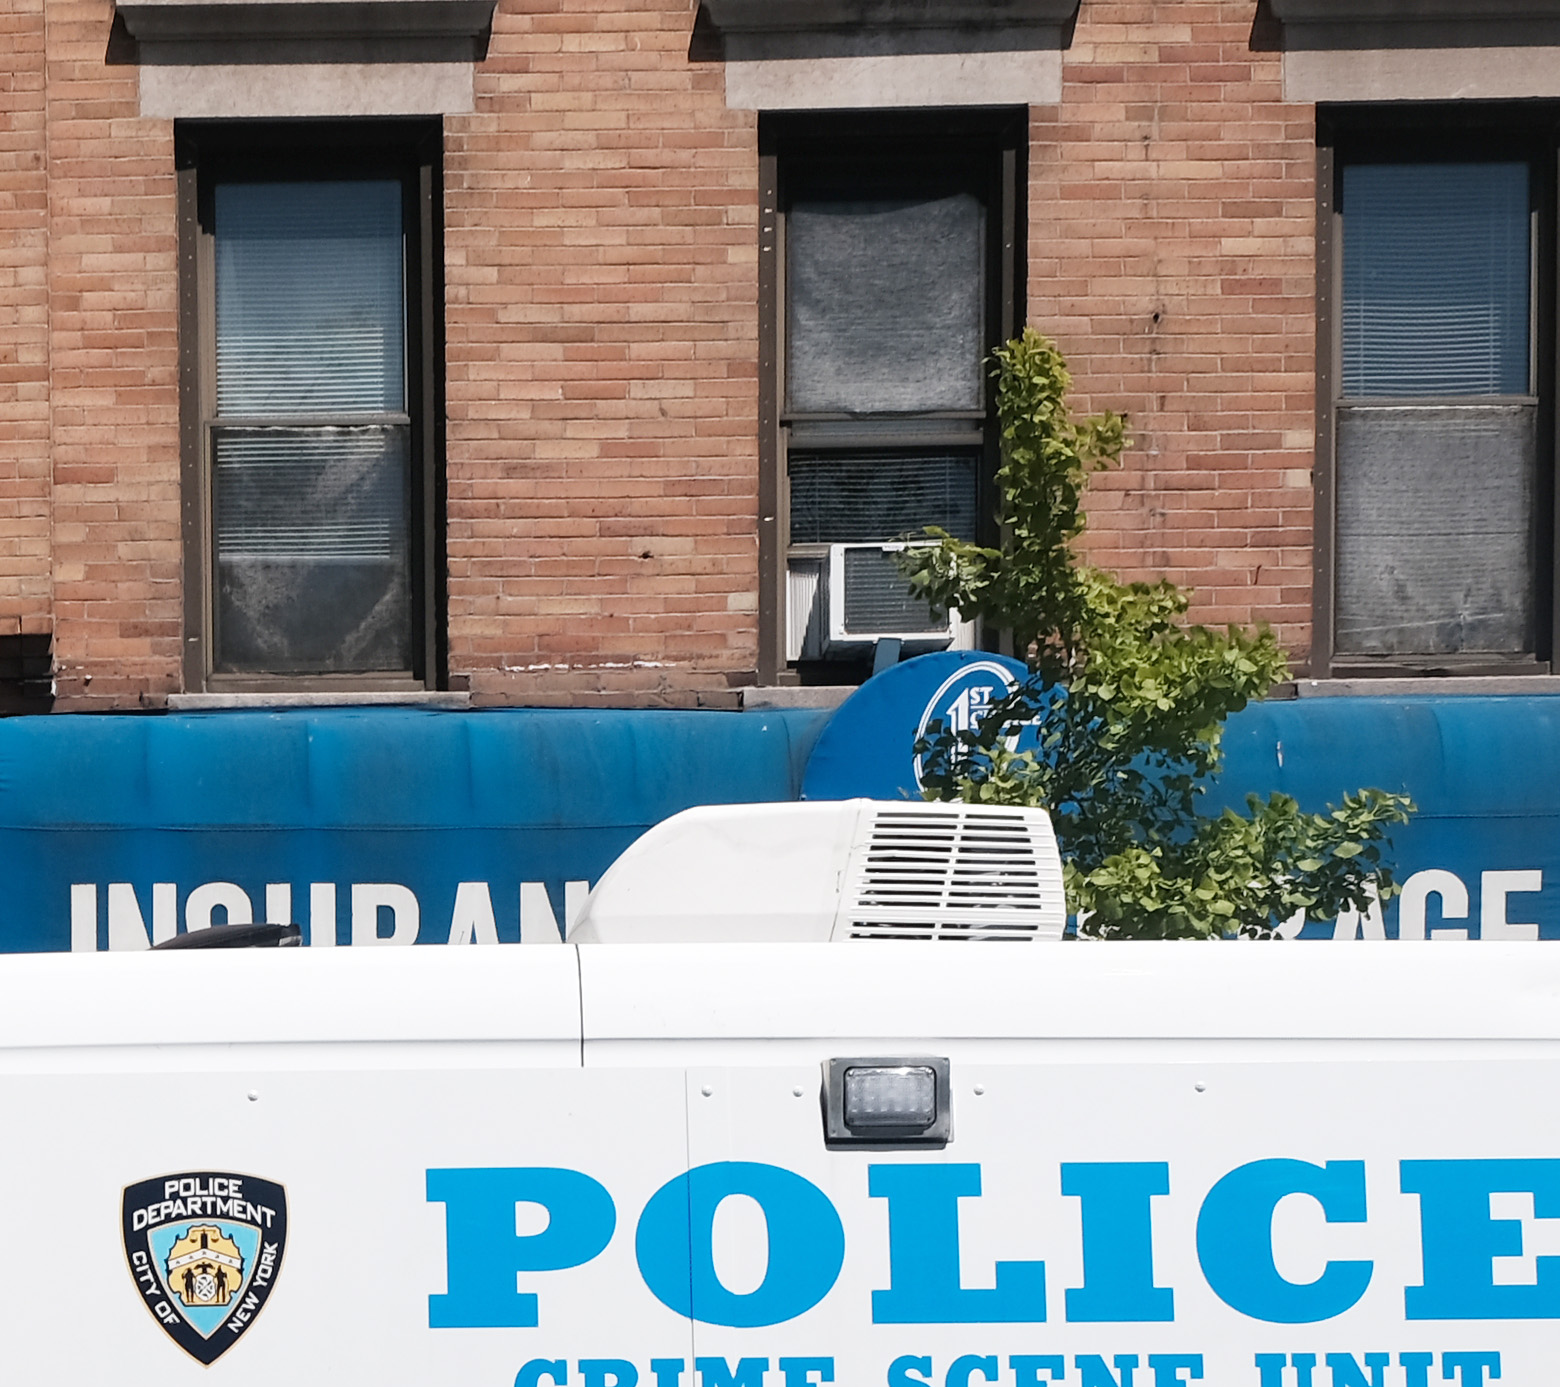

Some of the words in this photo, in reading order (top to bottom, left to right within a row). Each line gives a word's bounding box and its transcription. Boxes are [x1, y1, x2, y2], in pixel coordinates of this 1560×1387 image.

[133, 1197, 276, 1231] DEPARTMENT
[165, 1178, 243, 1199] POLICE
[133, 1251, 161, 1296] CITY
[154, 1301, 180, 1325] OF
[227, 1292, 260, 1333] NEW
[253, 1242, 278, 1287] YORK
